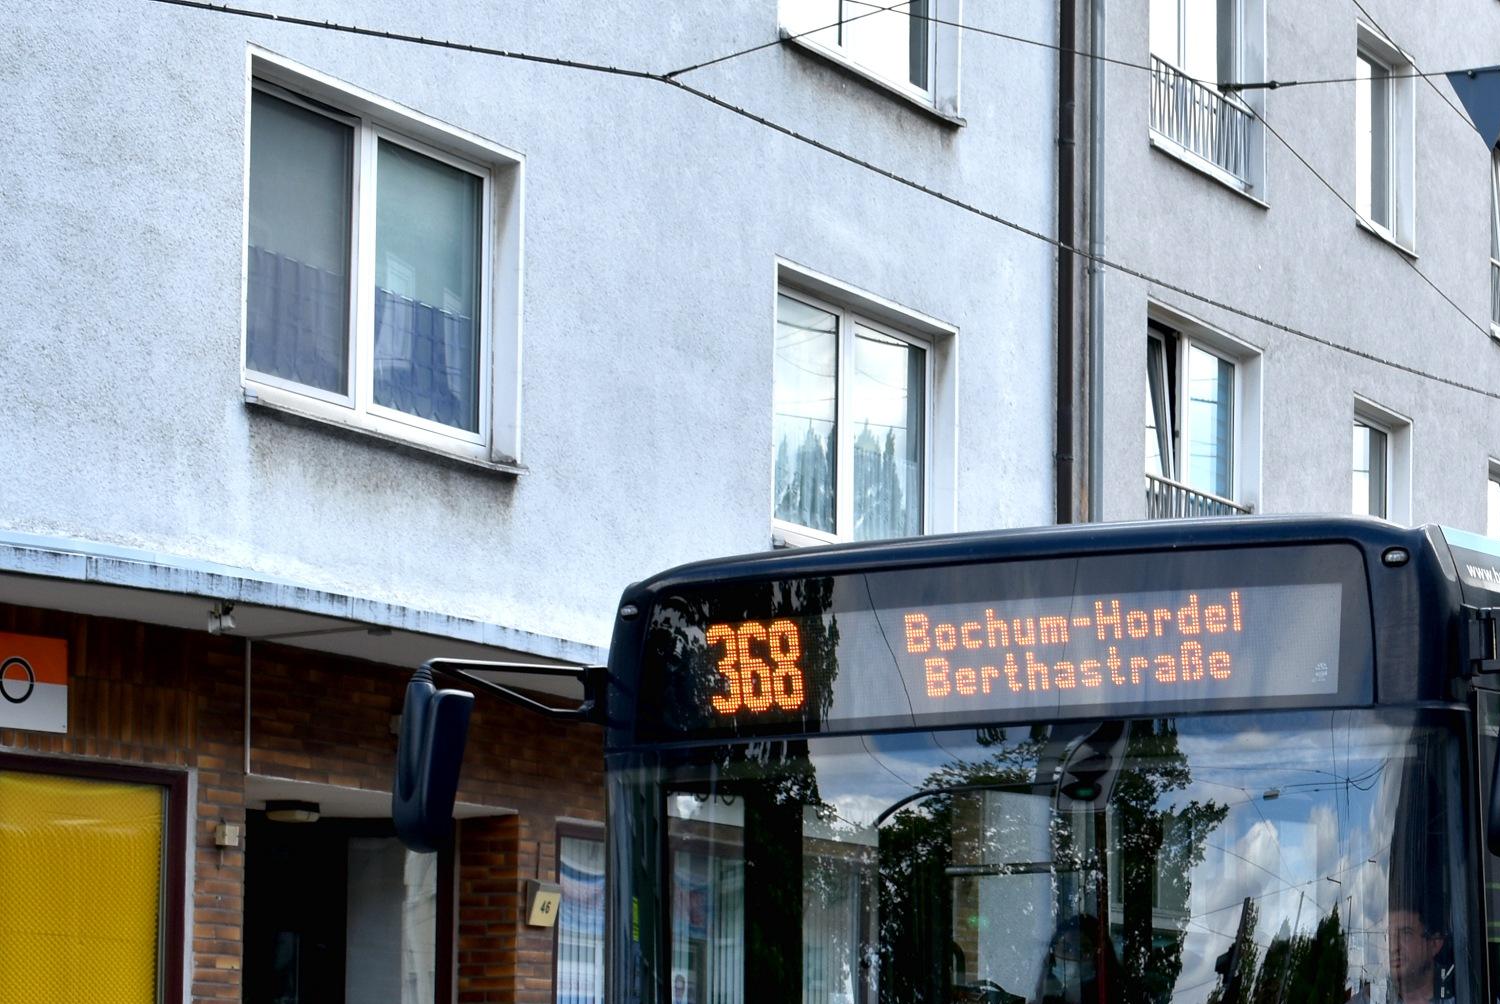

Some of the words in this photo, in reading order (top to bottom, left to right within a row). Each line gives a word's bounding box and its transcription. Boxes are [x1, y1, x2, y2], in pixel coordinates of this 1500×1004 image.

[904, 591, 1243, 654] Bochum-Hordel
[706, 618, 806, 715] 368
[925, 640, 1233, 698] Berthastraße
[540, 900, 551, 915] 46
